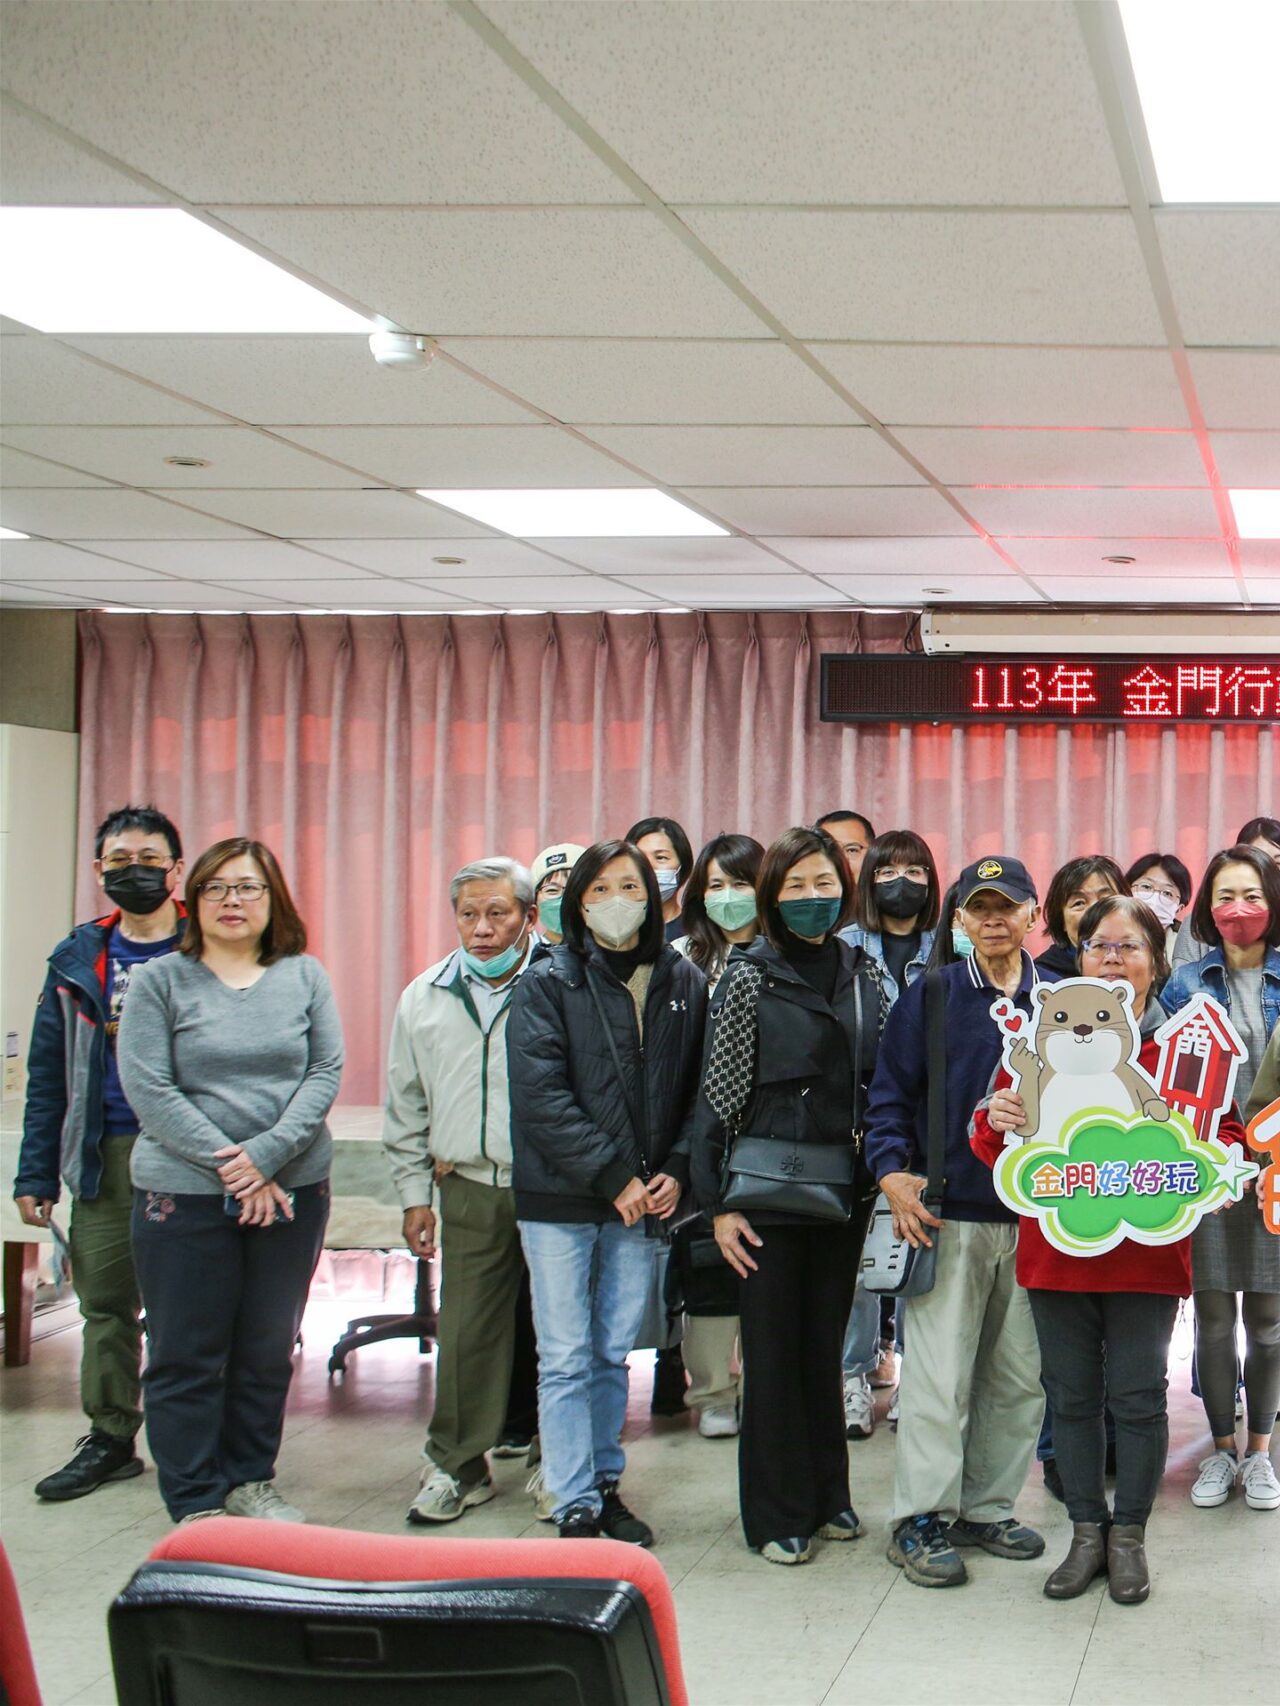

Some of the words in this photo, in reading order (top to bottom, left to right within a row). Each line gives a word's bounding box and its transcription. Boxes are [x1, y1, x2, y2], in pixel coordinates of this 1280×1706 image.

[972, 665, 1096, 714] 113年
[1030, 1161, 1200, 1197] 金門好好玩
